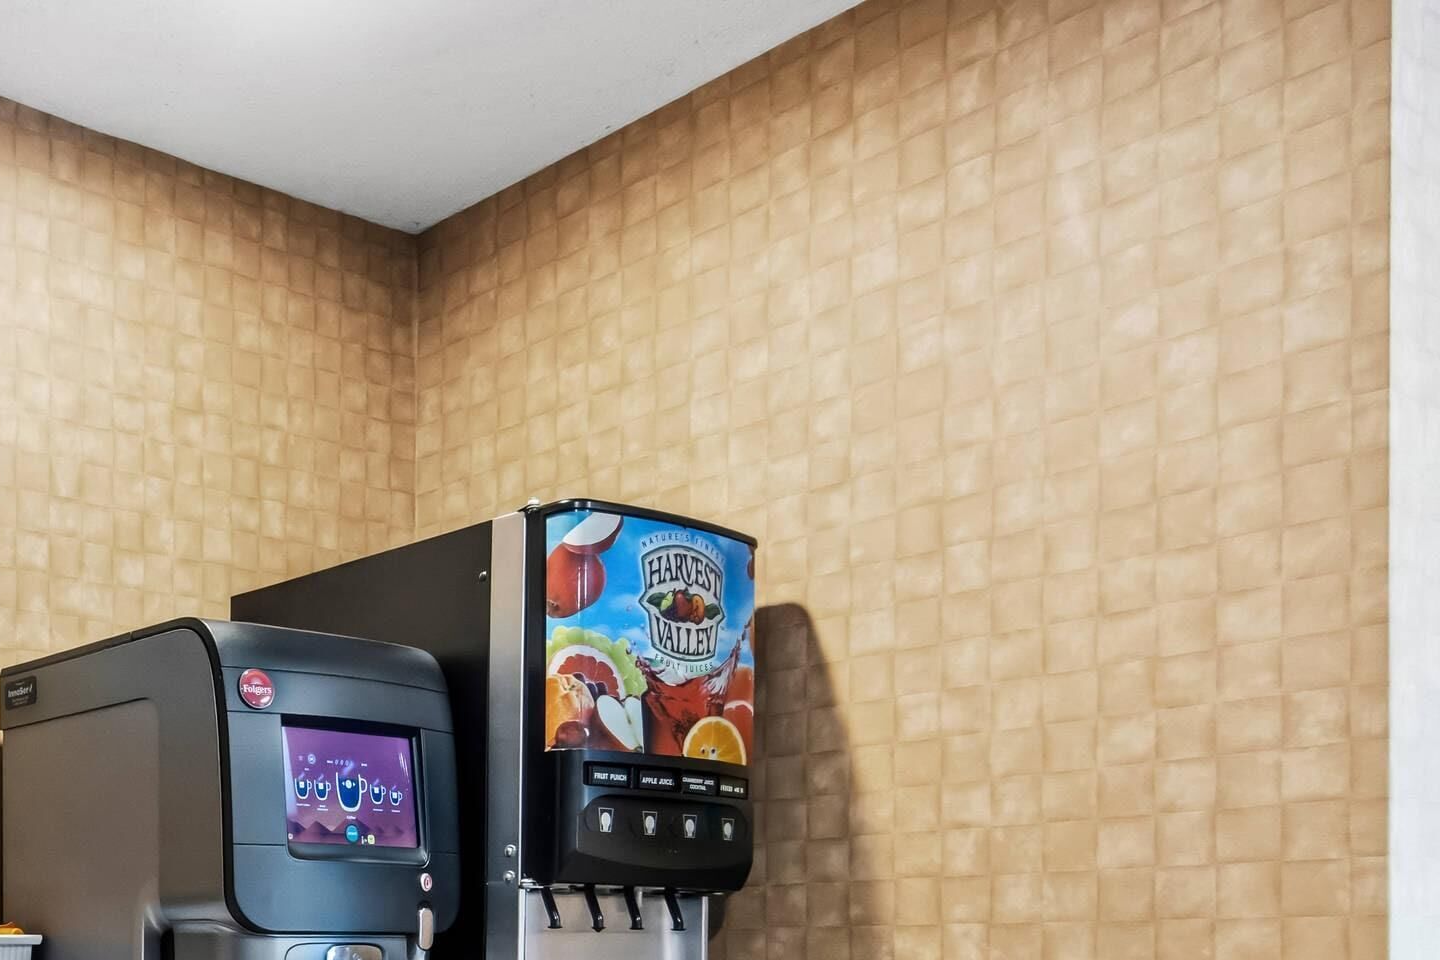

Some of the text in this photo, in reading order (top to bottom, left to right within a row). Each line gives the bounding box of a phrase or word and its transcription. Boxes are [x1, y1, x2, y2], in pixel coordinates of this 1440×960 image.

[641, 532, 690, 549] NATURE'S
[648, 553, 721, 600] HARVEST
[654, 613, 714, 656] VALLEY
[654, 653, 713, 673] FRUIT JUICES
[243, 684, 272, 696] Folgers
[594, 772, 628, 782] FRUIT PUNCH
[641, 776, 673, 786] APPLE JUICE
